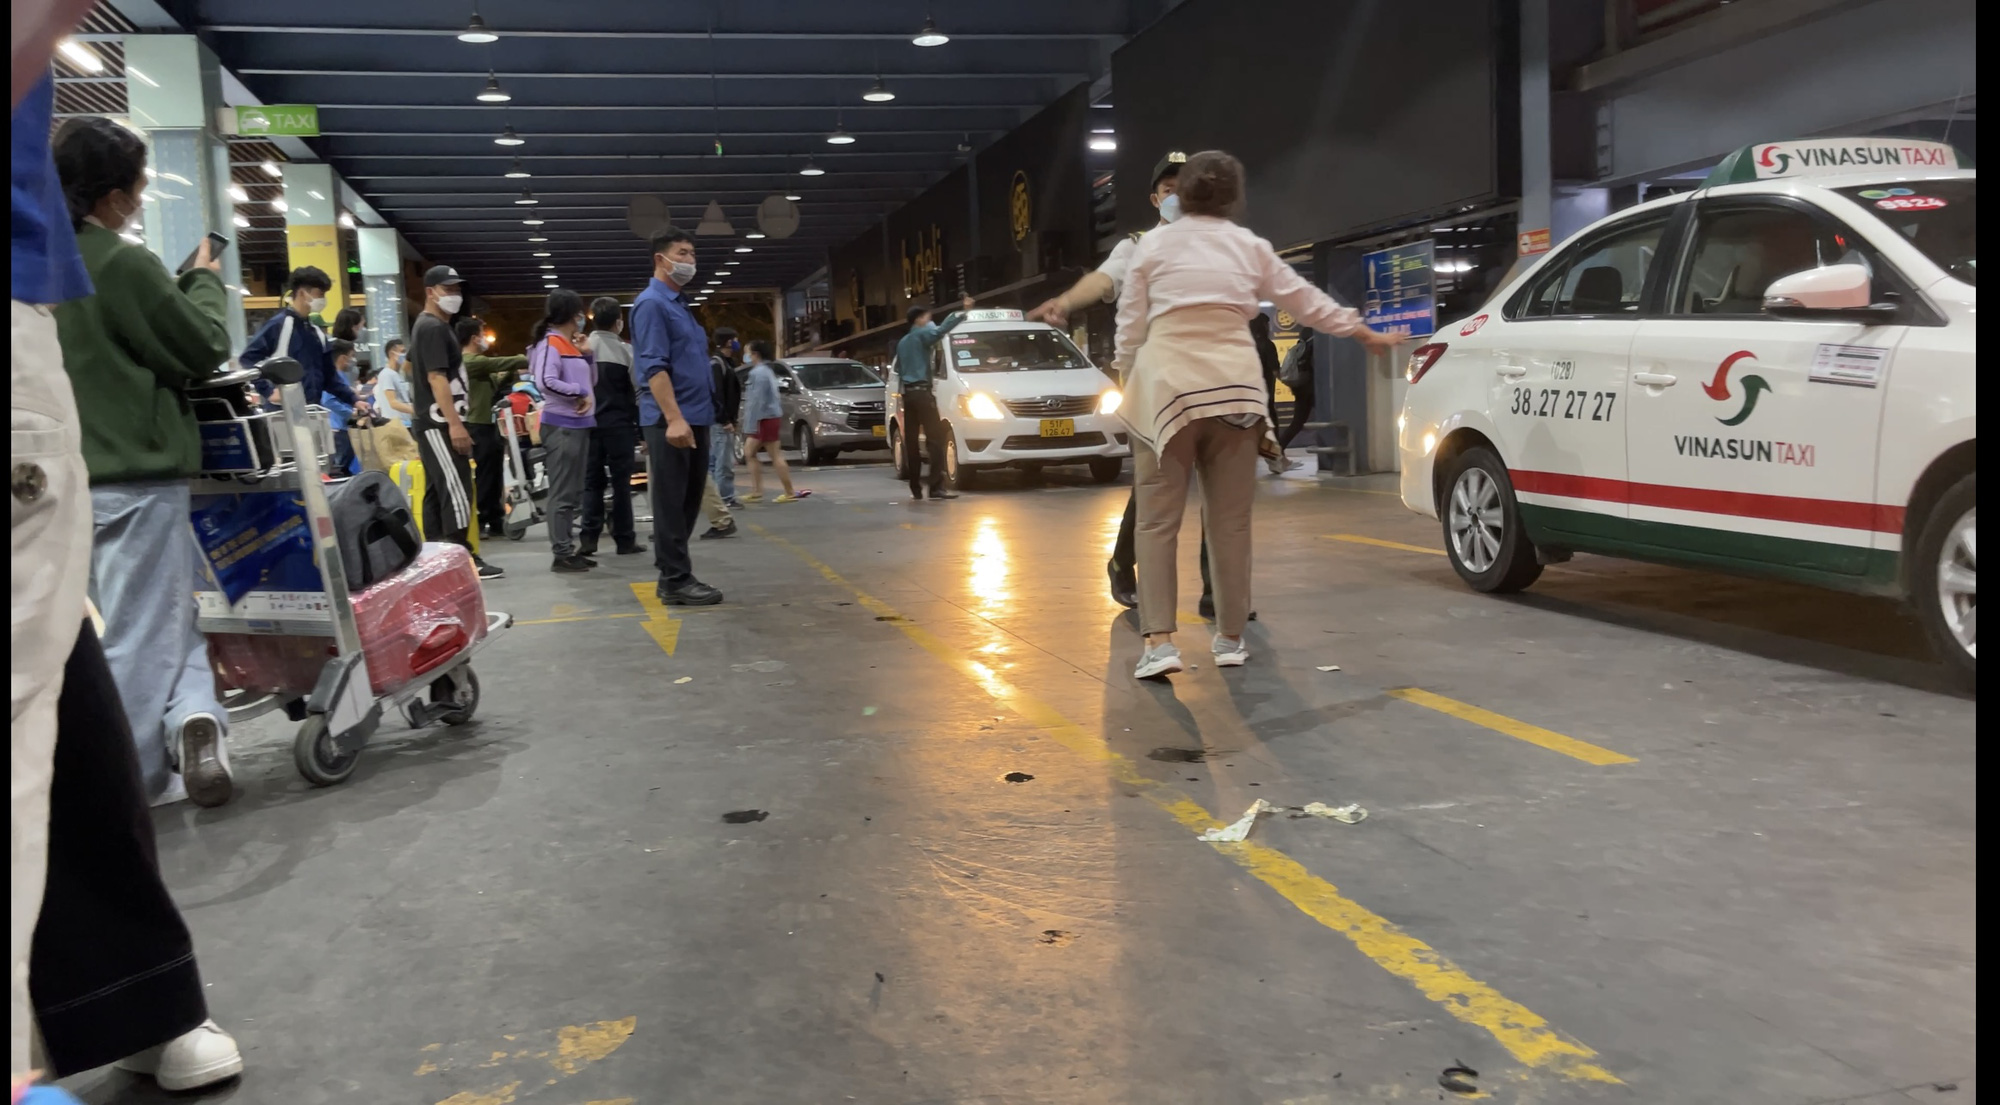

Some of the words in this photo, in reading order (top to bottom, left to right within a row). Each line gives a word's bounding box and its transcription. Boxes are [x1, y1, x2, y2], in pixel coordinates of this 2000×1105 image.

[272, 113, 316, 129] TAXI
[1877, 197, 1945, 209] 9824
[1551, 360, 1576, 380] (028)
[1511, 387, 1561, 418] 38.27
[1564, 389, 1588, 420] 27
[1592, 391, 1617, 422] 27
